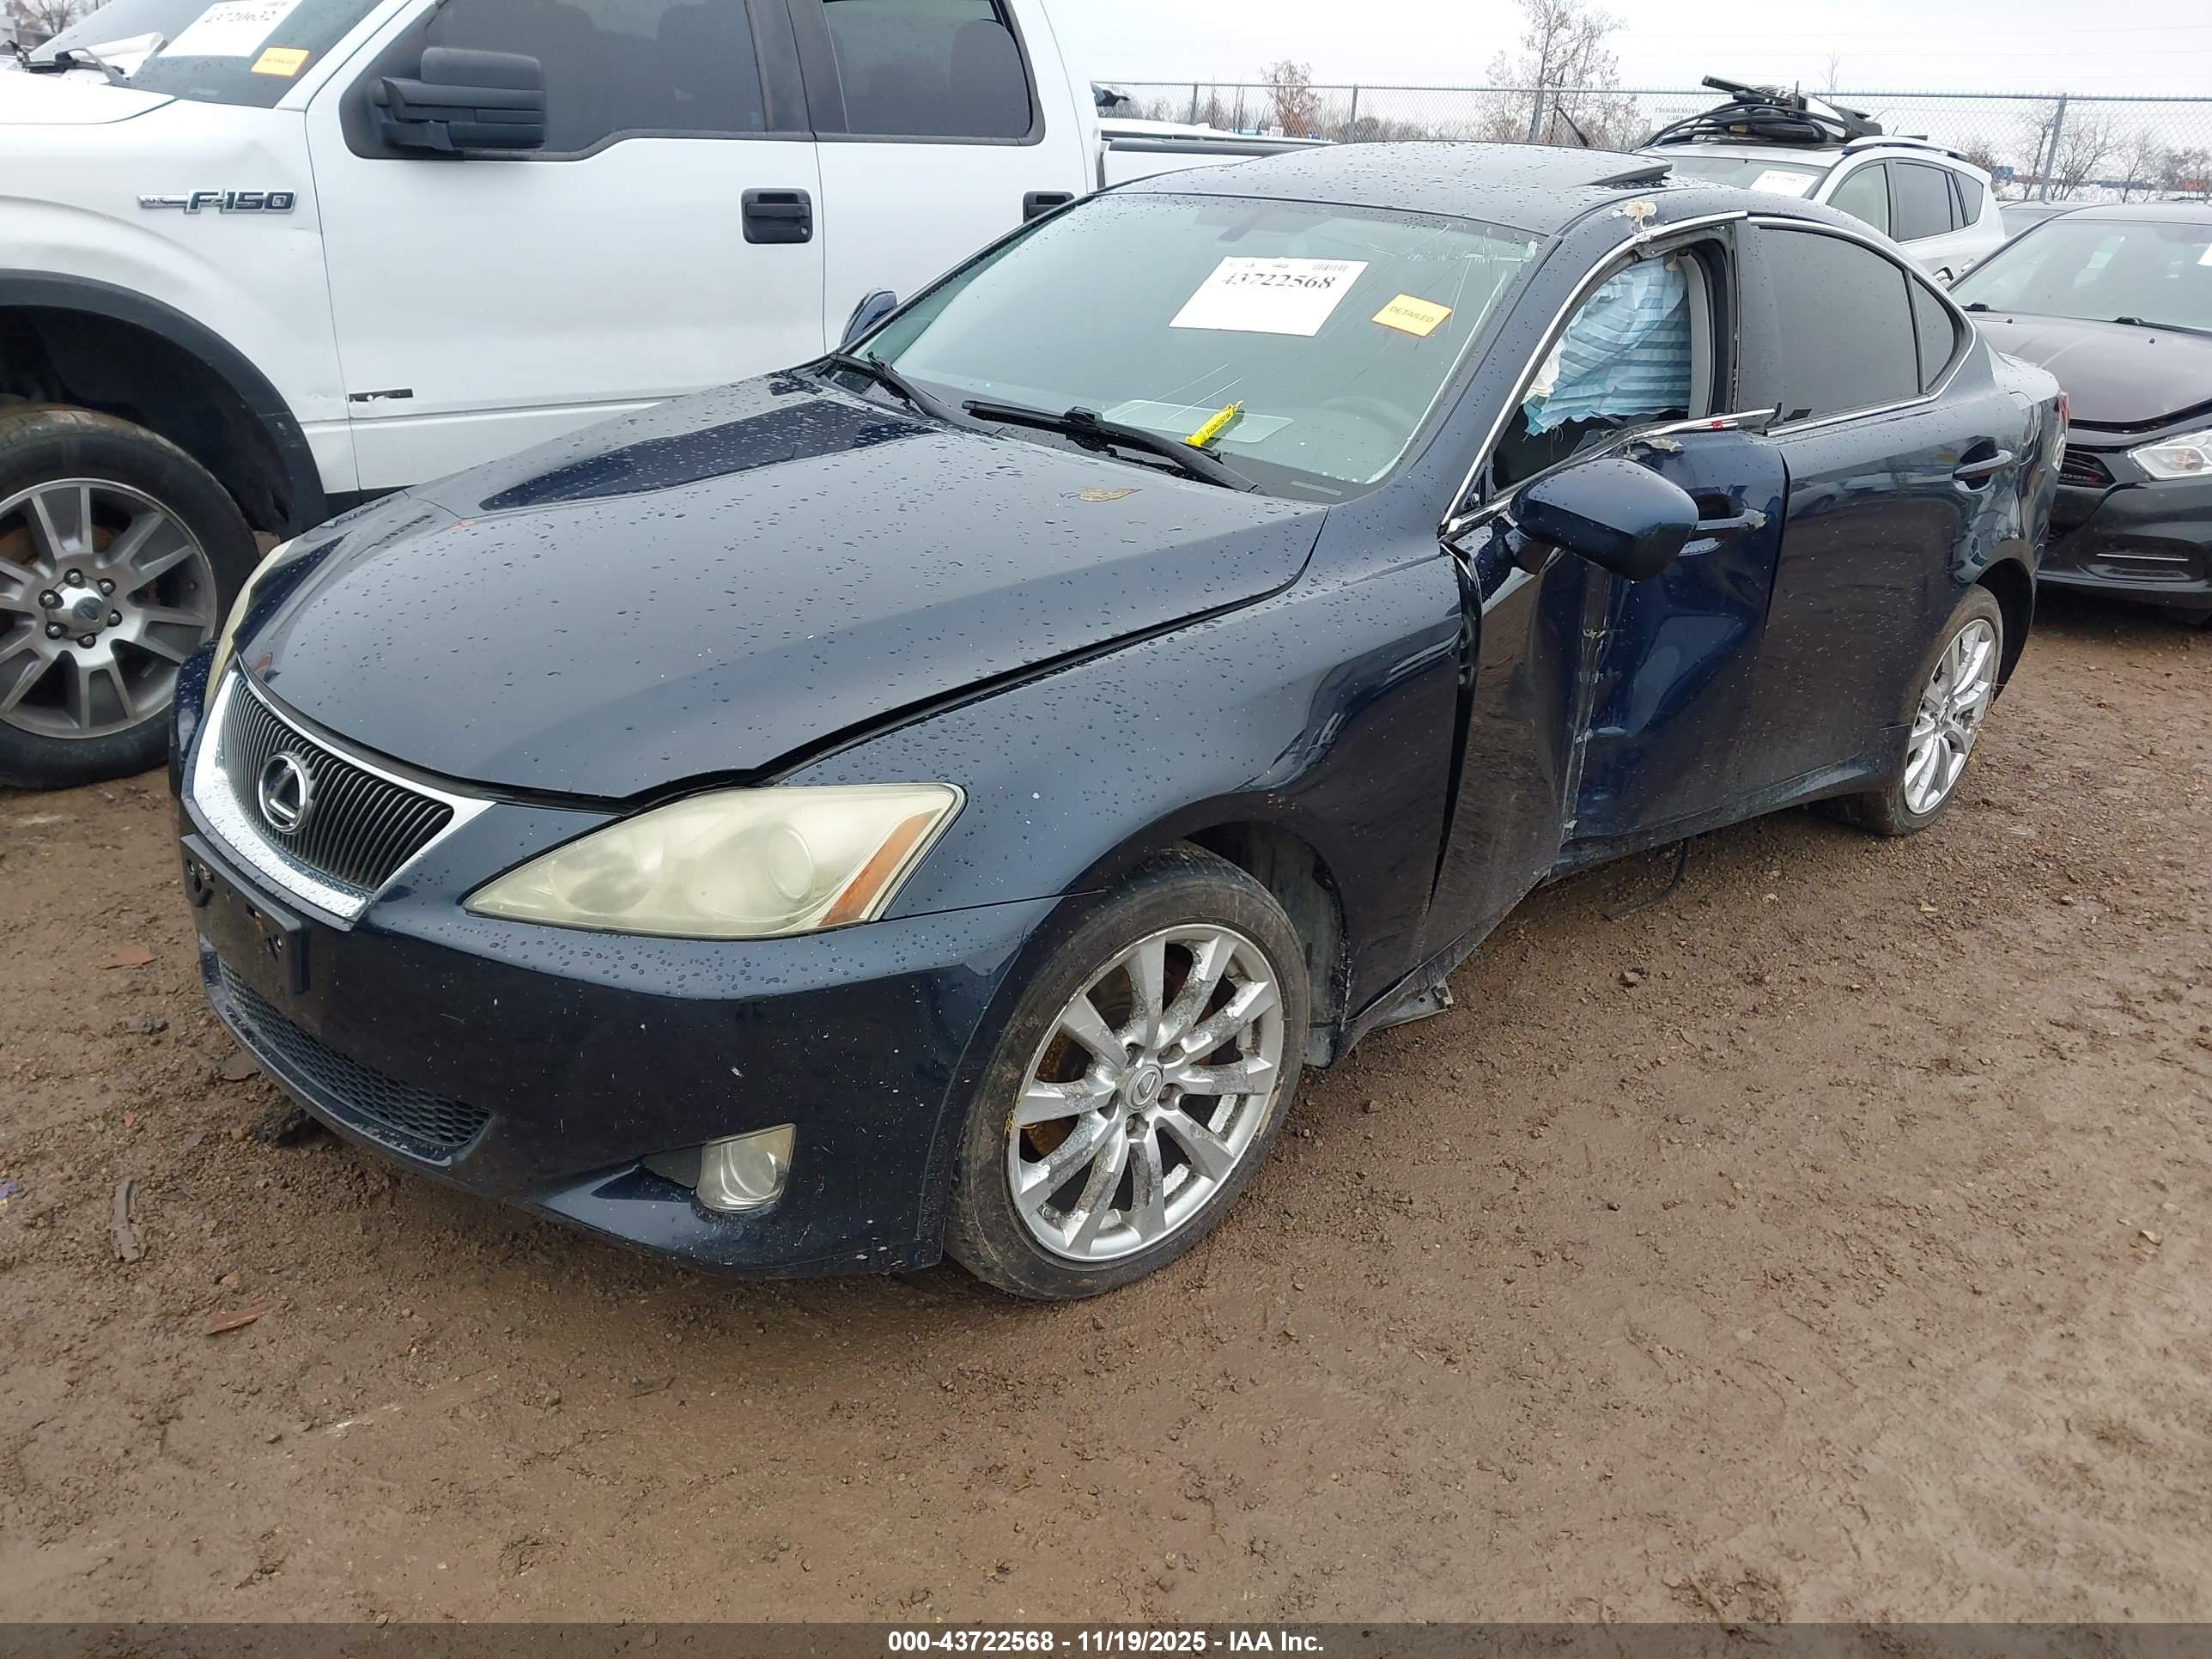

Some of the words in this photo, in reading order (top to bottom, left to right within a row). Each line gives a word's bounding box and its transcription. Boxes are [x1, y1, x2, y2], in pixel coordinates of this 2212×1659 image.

[186, 191, 295, 212] F-150
[1222, 272, 1336, 289] 43722568
[1389, 306, 1434, 323] DETAILED
